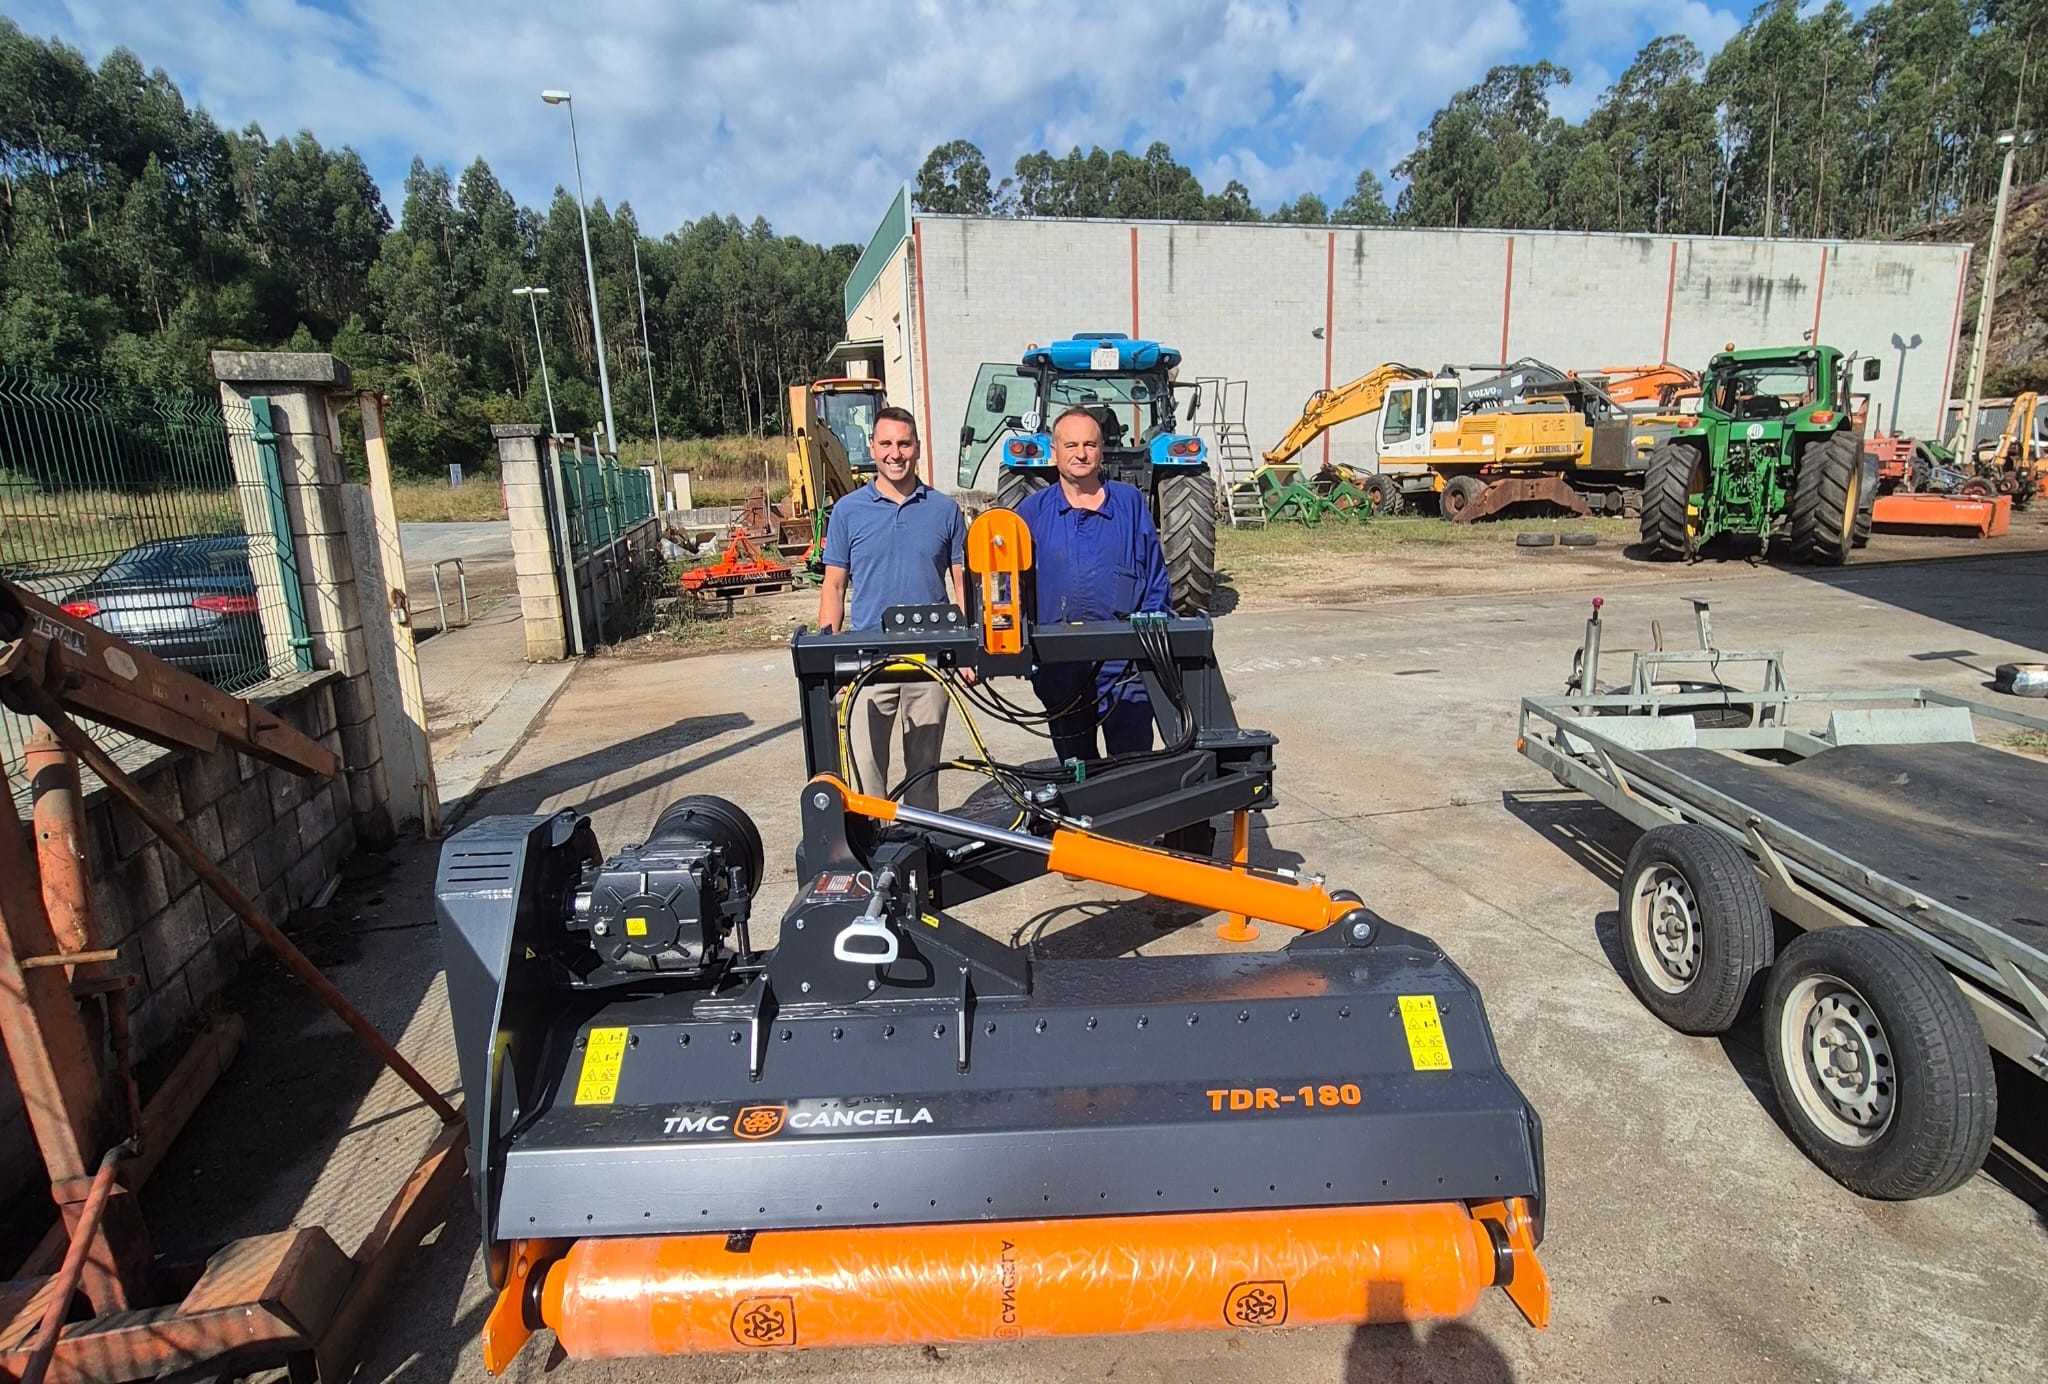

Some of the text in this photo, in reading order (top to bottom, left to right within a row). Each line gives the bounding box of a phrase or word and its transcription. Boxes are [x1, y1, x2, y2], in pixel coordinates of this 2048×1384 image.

[1468, 387, 1497, 398] VOLVO
[1023, 413, 1038, 429] 40
[1206, 1084, 1362, 1112] TDR-180
[663, 1107, 934, 1134] TMC CANCELA
